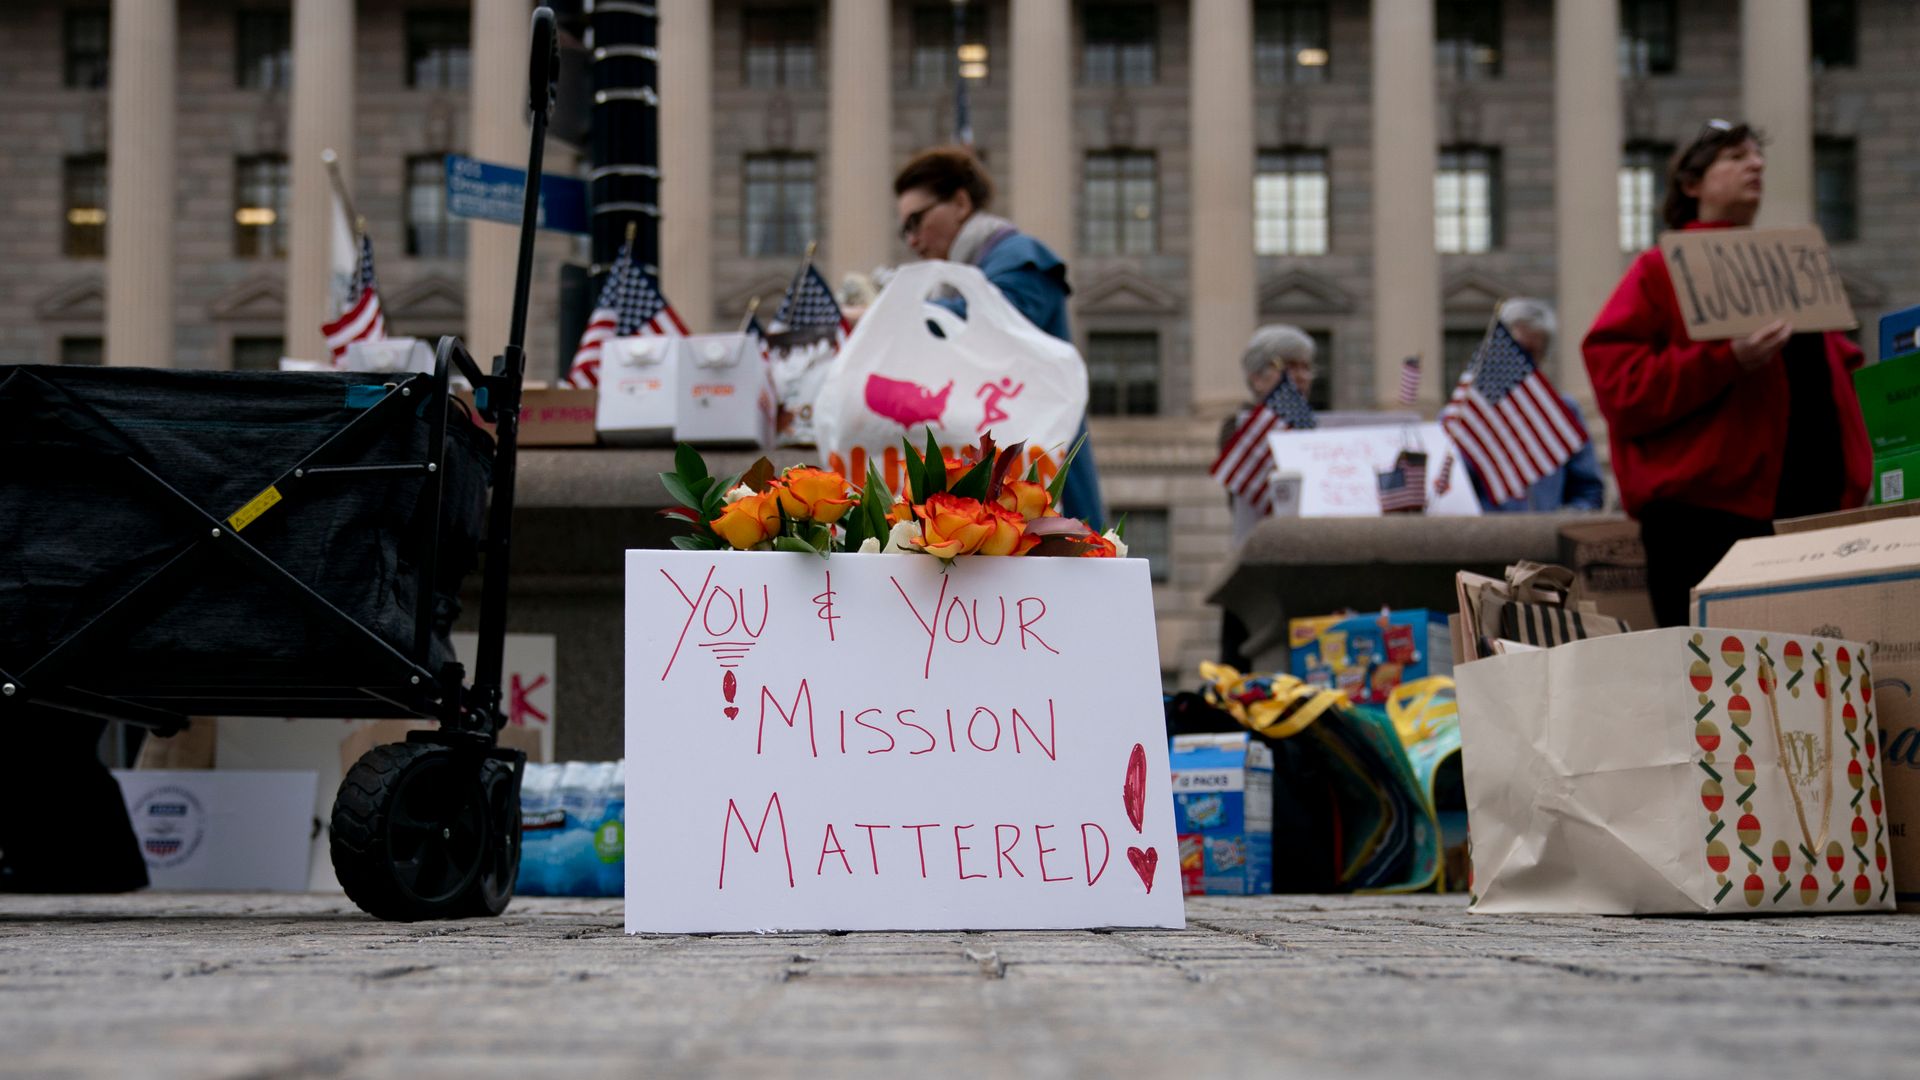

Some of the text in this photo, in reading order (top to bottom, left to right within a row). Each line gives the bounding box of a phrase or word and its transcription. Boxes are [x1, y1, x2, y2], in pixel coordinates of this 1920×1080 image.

[661, 565, 769, 681] YOU
[890, 574, 1060, 679] YOUR
[757, 678, 1056, 761] MISSION
[1192, 774, 1229, 787] PACKS
